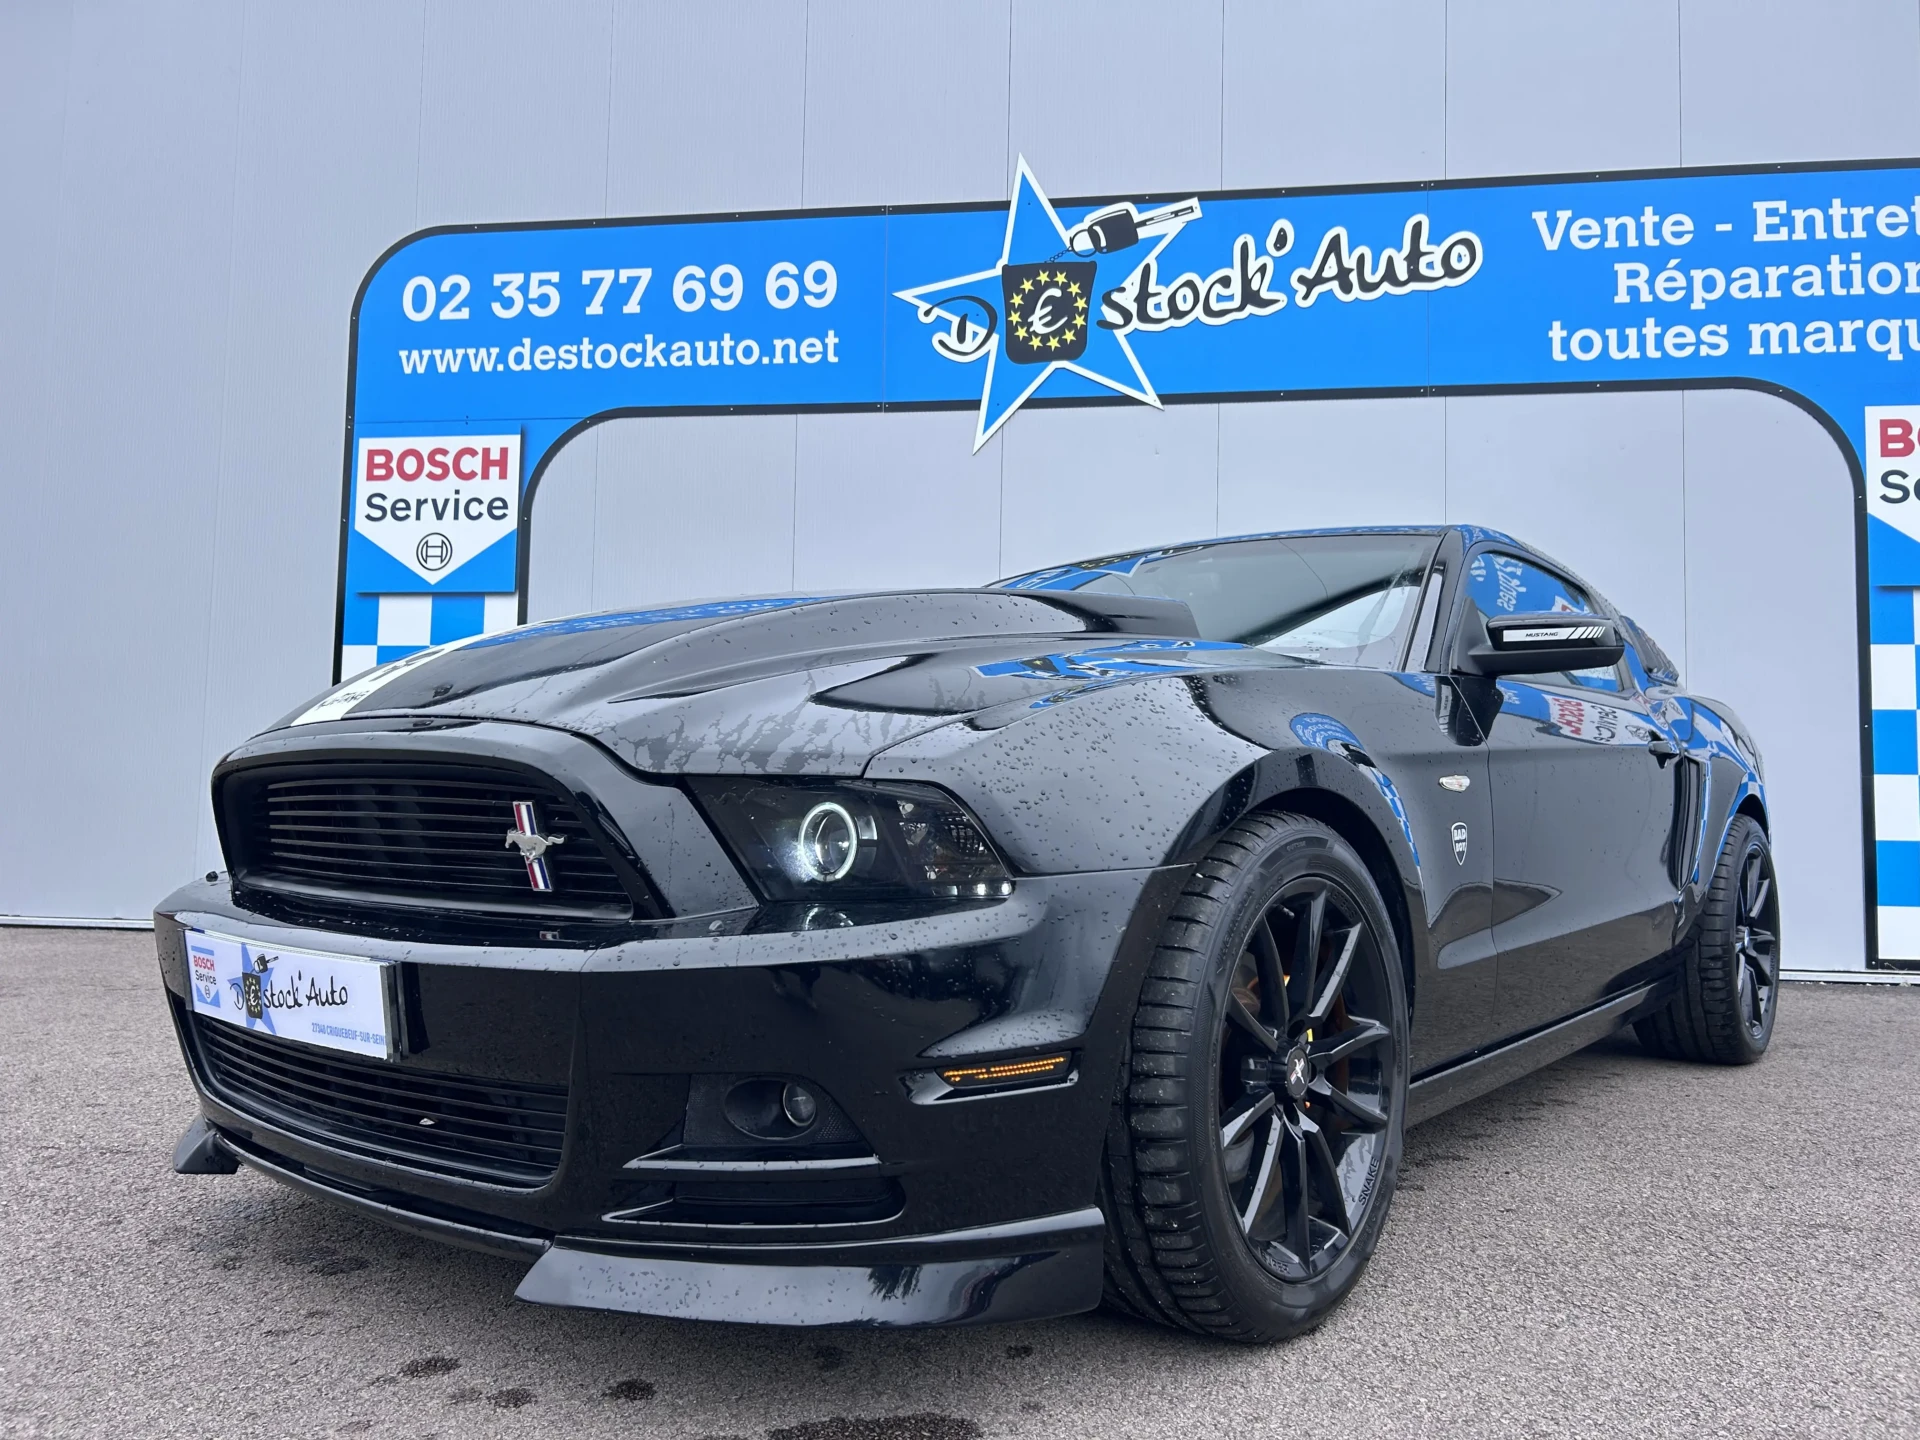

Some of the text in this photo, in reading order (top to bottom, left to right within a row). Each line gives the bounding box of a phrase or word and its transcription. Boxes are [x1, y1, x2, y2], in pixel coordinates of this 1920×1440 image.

[1531, 205, 1694, 251] Vente
[1715, 222, 1733, 232] -
[402, 260, 838, 322] 02 35 77 69 69
[399, 329, 839, 374] www.destockauto.net
[1548, 317, 1729, 362] toutes
[365, 447, 509, 482] BOSCH
[364, 489, 509, 522] Service
[1453, 828, 1466, 841] BAD
[1455, 842, 1466, 852] BOY
[193, 954, 215, 972] BOSCH
[195, 969, 217, 985] Service
[1358, 1155, 1380, 1206] SNAKE
